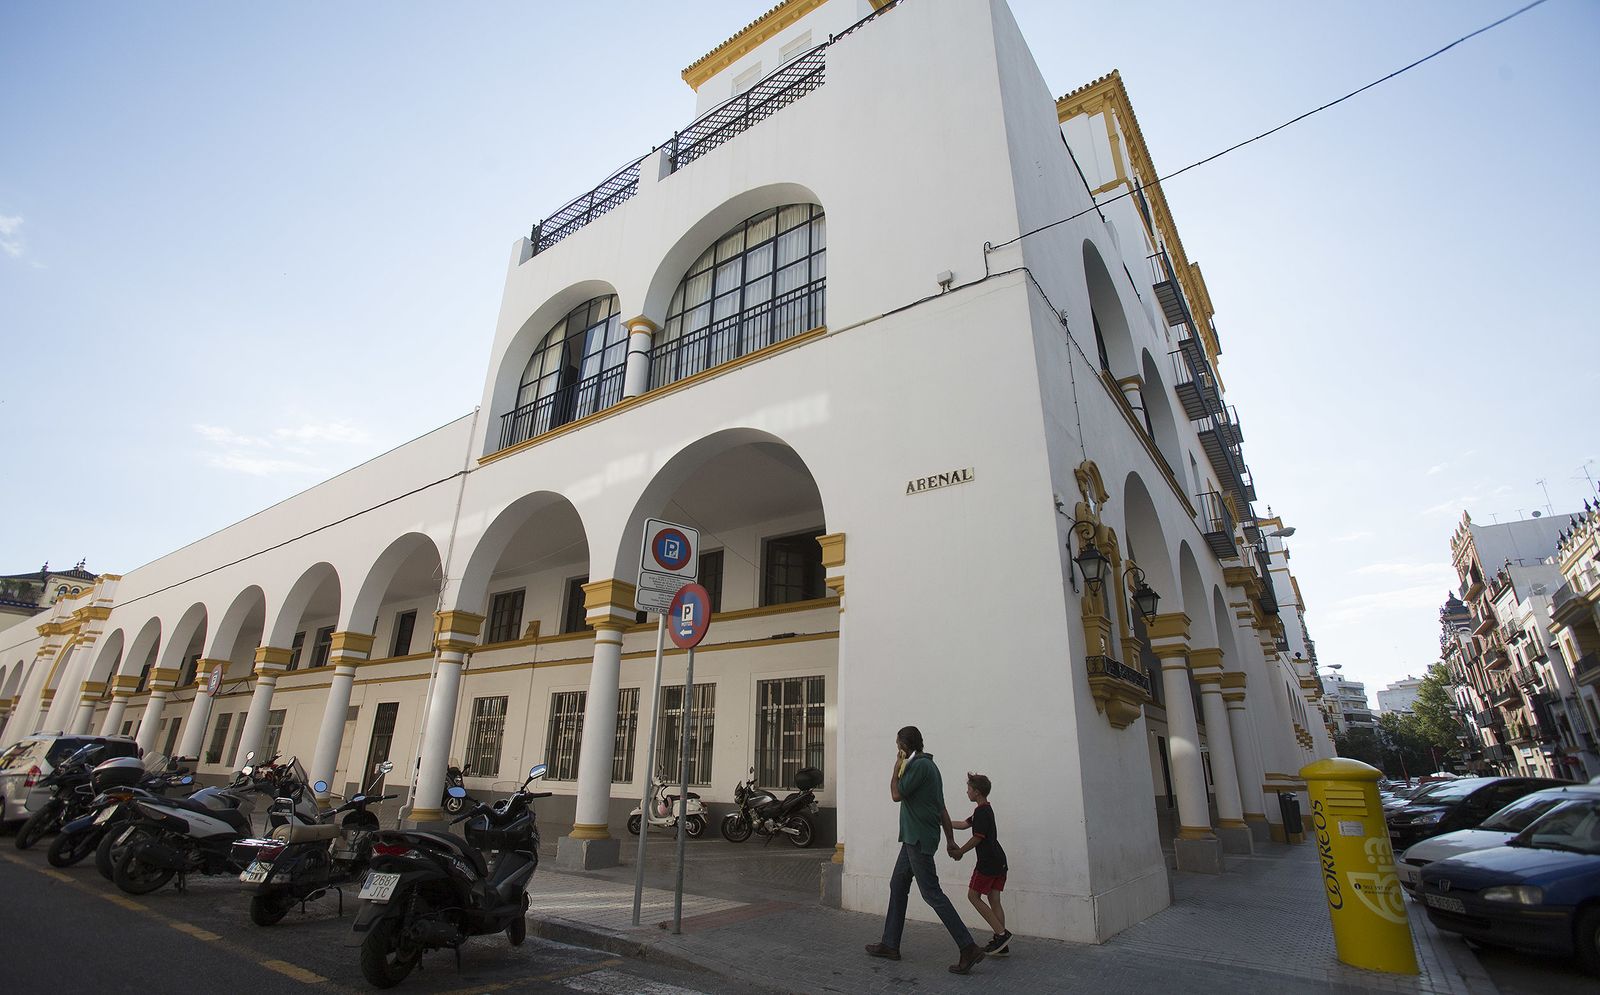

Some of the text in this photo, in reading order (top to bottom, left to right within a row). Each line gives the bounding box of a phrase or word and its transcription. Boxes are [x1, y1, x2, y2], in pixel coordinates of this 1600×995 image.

[906, 468, 972, 494] ARENAL
[684, 606, 692, 620] P
[1312, 799, 1344, 910] CORREOS
[373, 874, 399, 887] 2687
[370, 886, 390, 898] JTC
